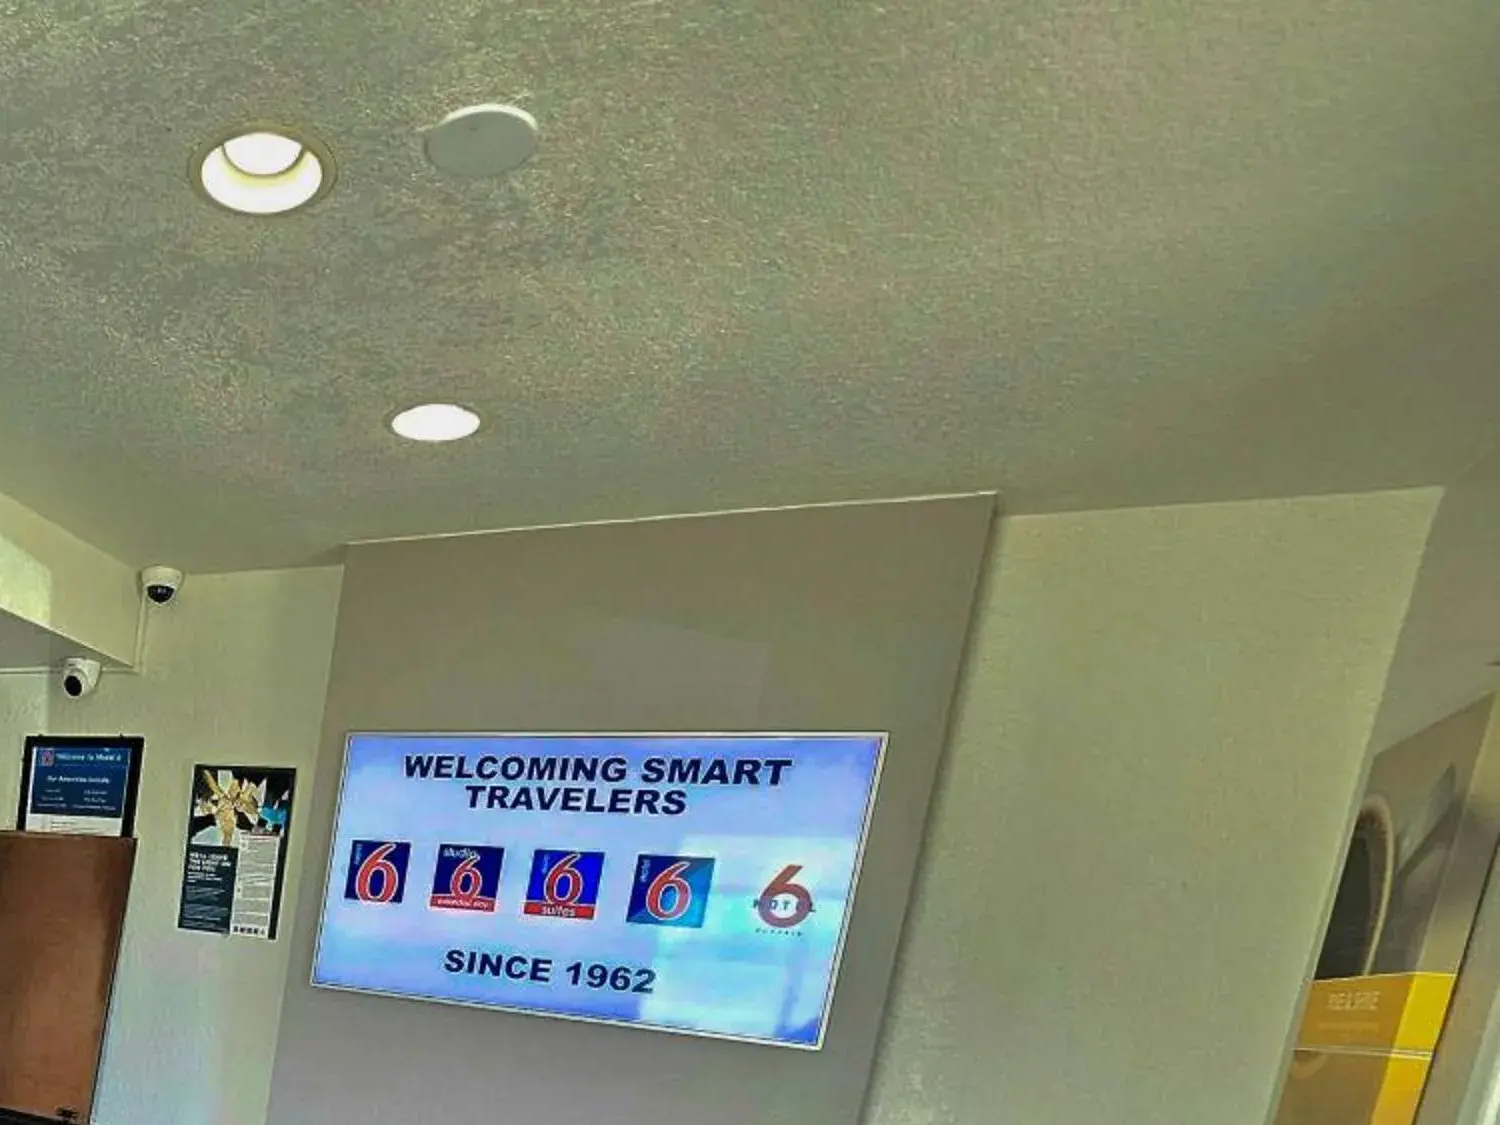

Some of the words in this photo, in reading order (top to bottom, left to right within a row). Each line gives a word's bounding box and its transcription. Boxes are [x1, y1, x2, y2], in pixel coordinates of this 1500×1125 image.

[404, 755, 628, 783] WELCOMING
[640, 757, 793, 785] SMART
[465, 785, 688, 816] TRAVELERS
[355, 842, 399, 905] 6
[645, 860, 692, 921] 6
[444, 949, 552, 983] SINCE
[566, 960, 657, 994] 1962
